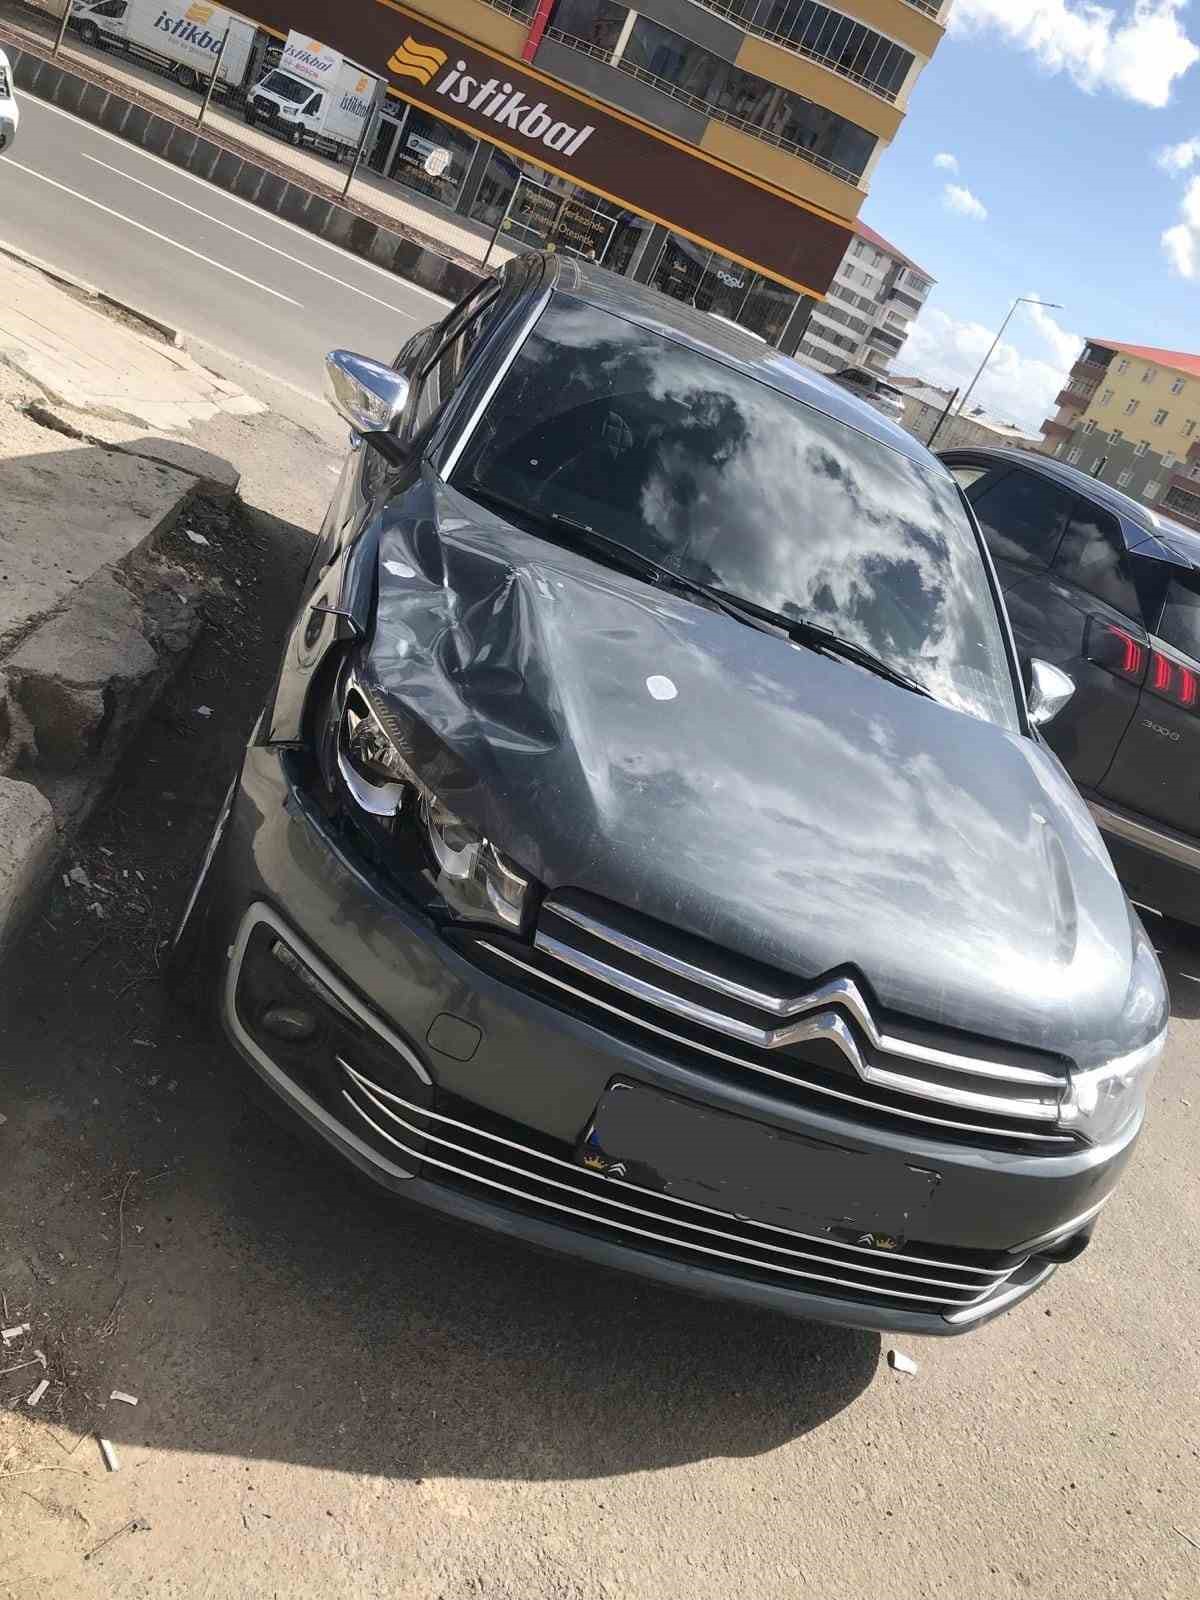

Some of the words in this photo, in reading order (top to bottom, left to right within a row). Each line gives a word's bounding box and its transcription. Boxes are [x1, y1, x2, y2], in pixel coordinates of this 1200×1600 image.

[153, 10, 224, 54] istikba
[284, 44, 333, 72] istikbal
[436, 60, 596, 157] istikbal
